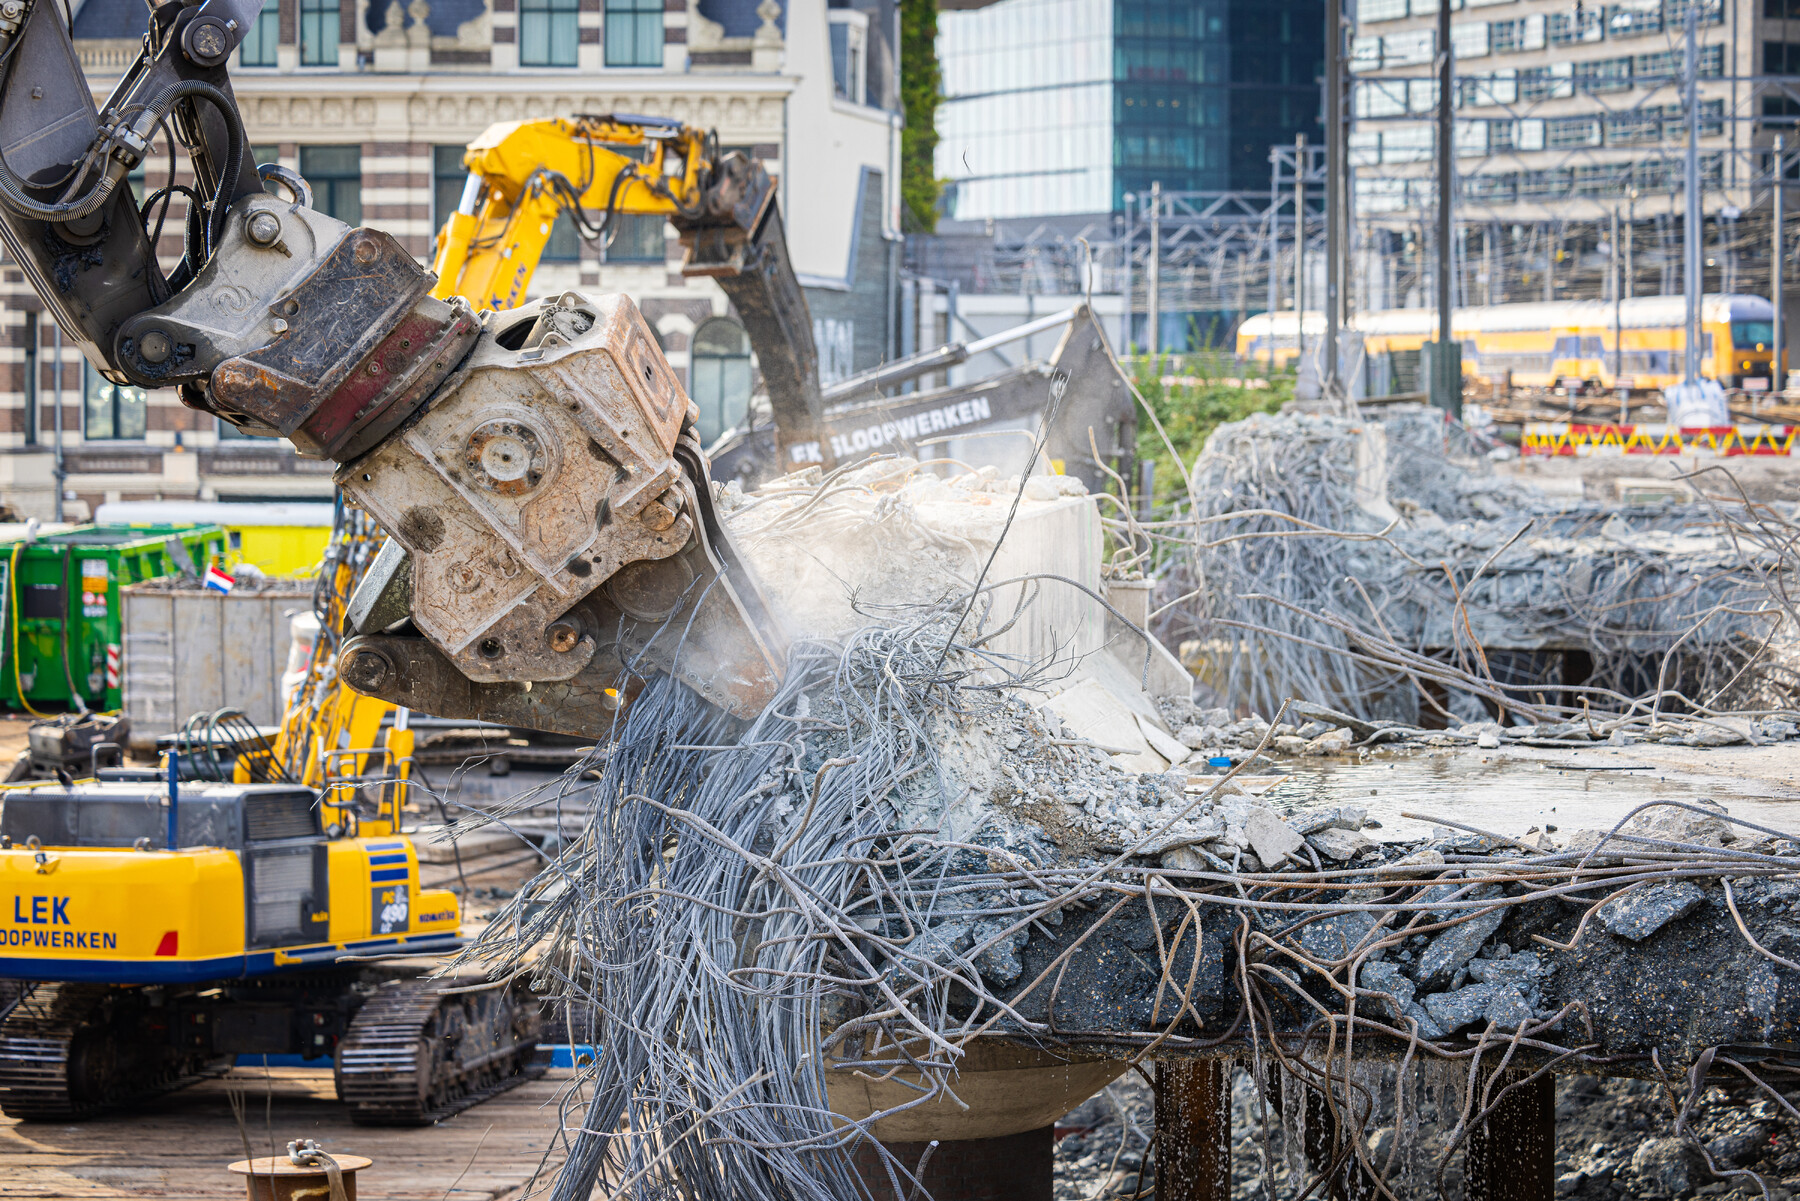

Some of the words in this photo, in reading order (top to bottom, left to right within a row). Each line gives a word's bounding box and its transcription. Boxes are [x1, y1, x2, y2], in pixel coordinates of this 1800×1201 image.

[14, 895, 71, 925] LEK
[380, 903, 408, 923] 490
[0, 929, 116, 949] OOPWERKEN
